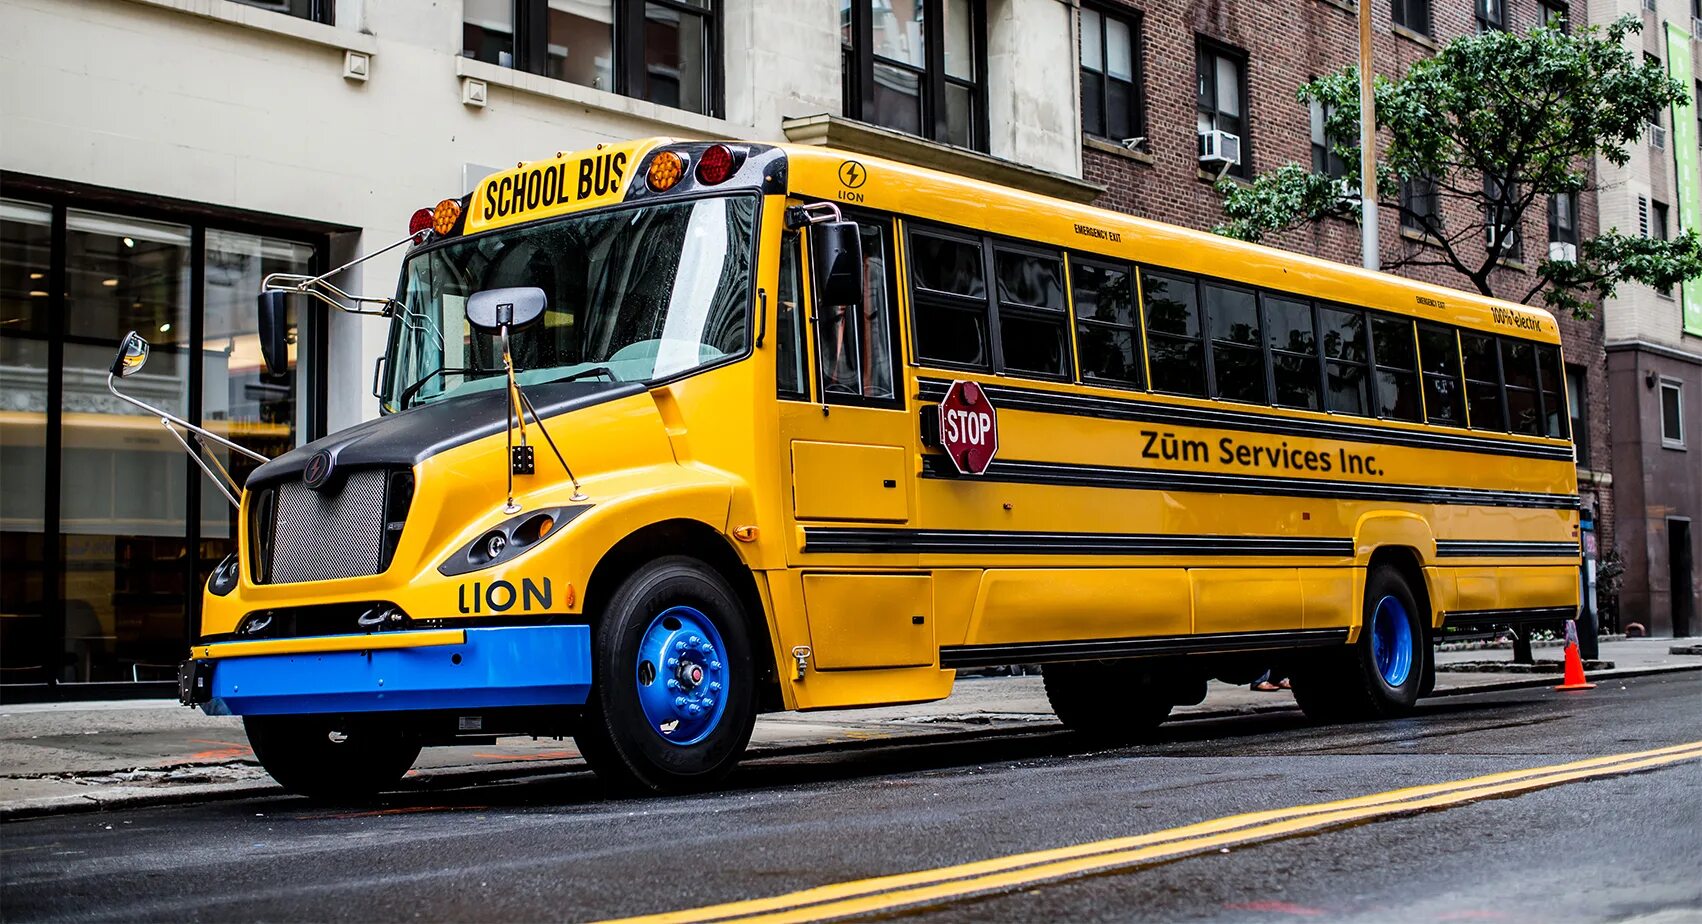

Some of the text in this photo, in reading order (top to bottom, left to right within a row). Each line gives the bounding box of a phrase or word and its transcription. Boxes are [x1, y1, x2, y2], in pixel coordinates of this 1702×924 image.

[484, 152, 627, 221] SCHOOL BUS
[838, 190, 864, 203] LION
[1074, 223, 1121, 243] EMERGENCY EXIT
[1415, 295, 1445, 310] EMERGENCY EXIT
[1490, 307, 1541, 332] 100% electric
[947, 408, 991, 446] STOP
[1140, 430, 1384, 476] Zūm Services Inc.
[459, 577, 552, 614] LION
